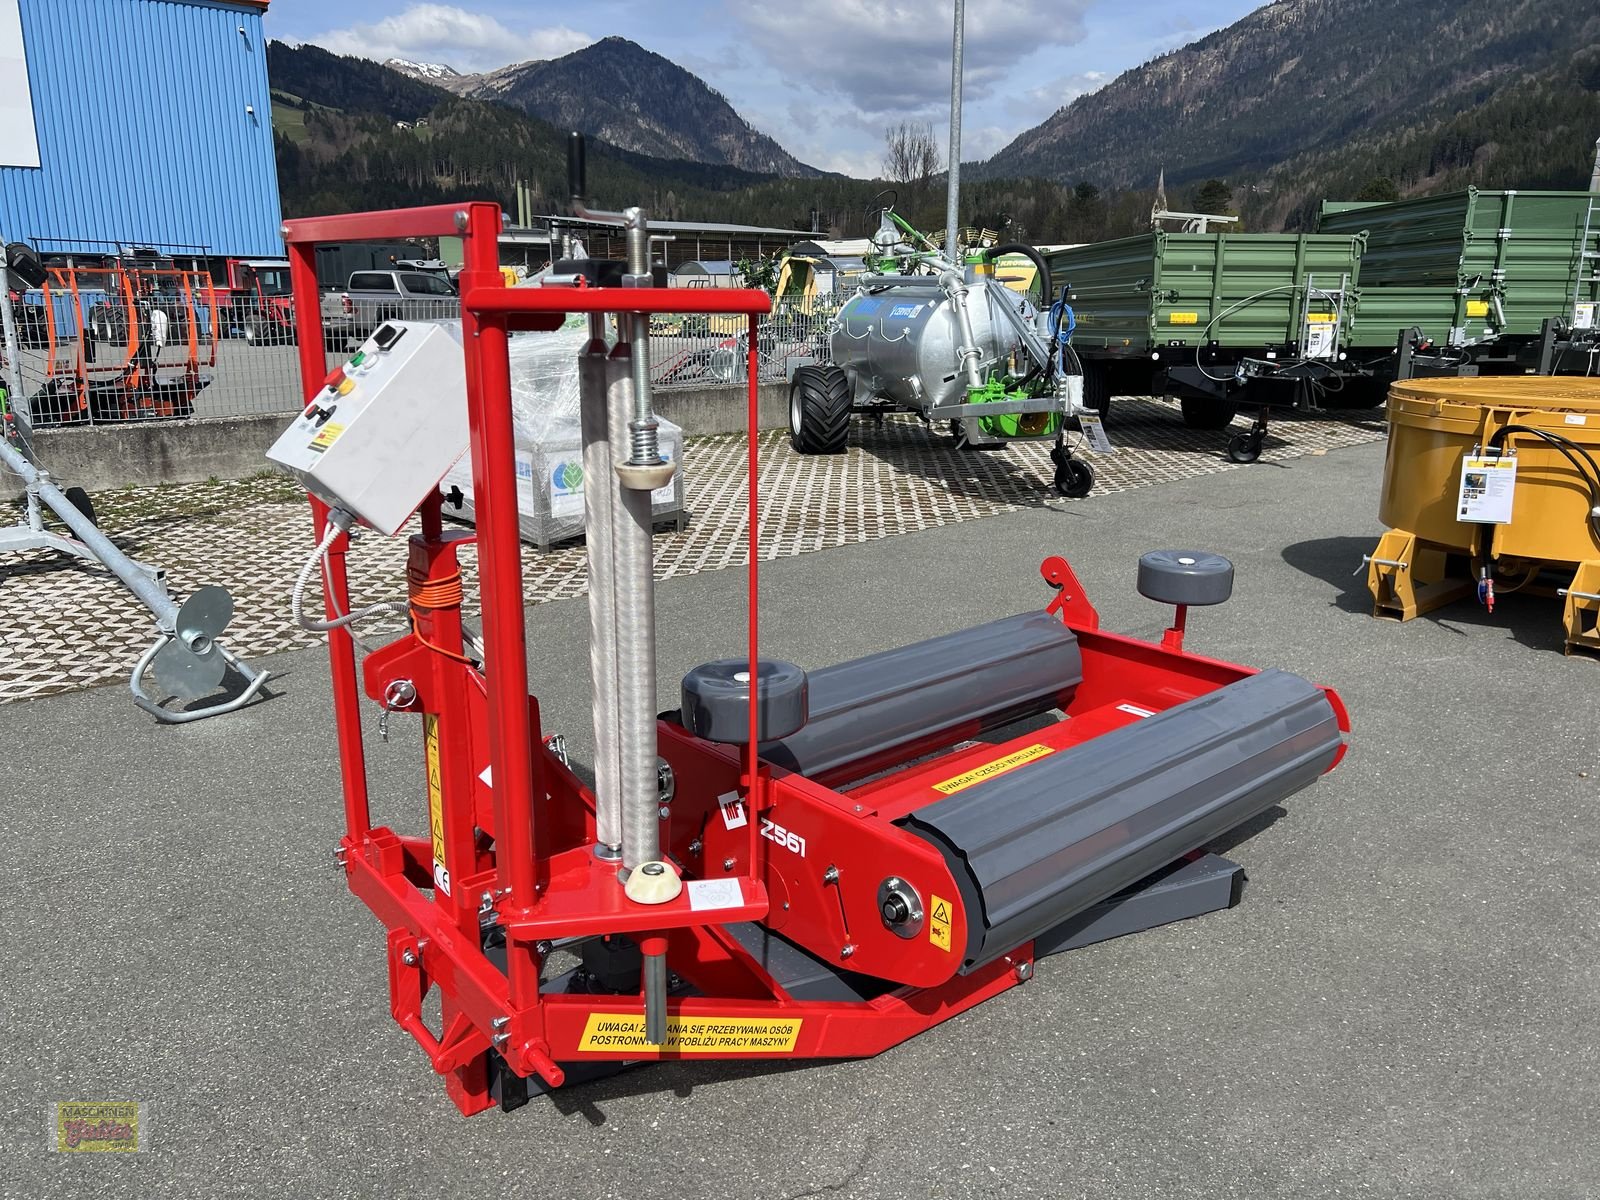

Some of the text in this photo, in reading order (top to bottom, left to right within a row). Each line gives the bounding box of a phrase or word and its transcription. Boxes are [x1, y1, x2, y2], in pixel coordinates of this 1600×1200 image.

[938, 774, 976, 792] UWAGA!
[760, 816, 806, 858] Z561
[597, 1022, 793, 1036] UWAGA! ZANIA SIĘ PRZEBYWANIA OSÓB
[667, 1037, 678, 1046] W
[678, 1036, 717, 1046] POBLIŻU
[719, 1037, 751, 1046] PRACY
[750, 1037, 790, 1046] MASZYNY
